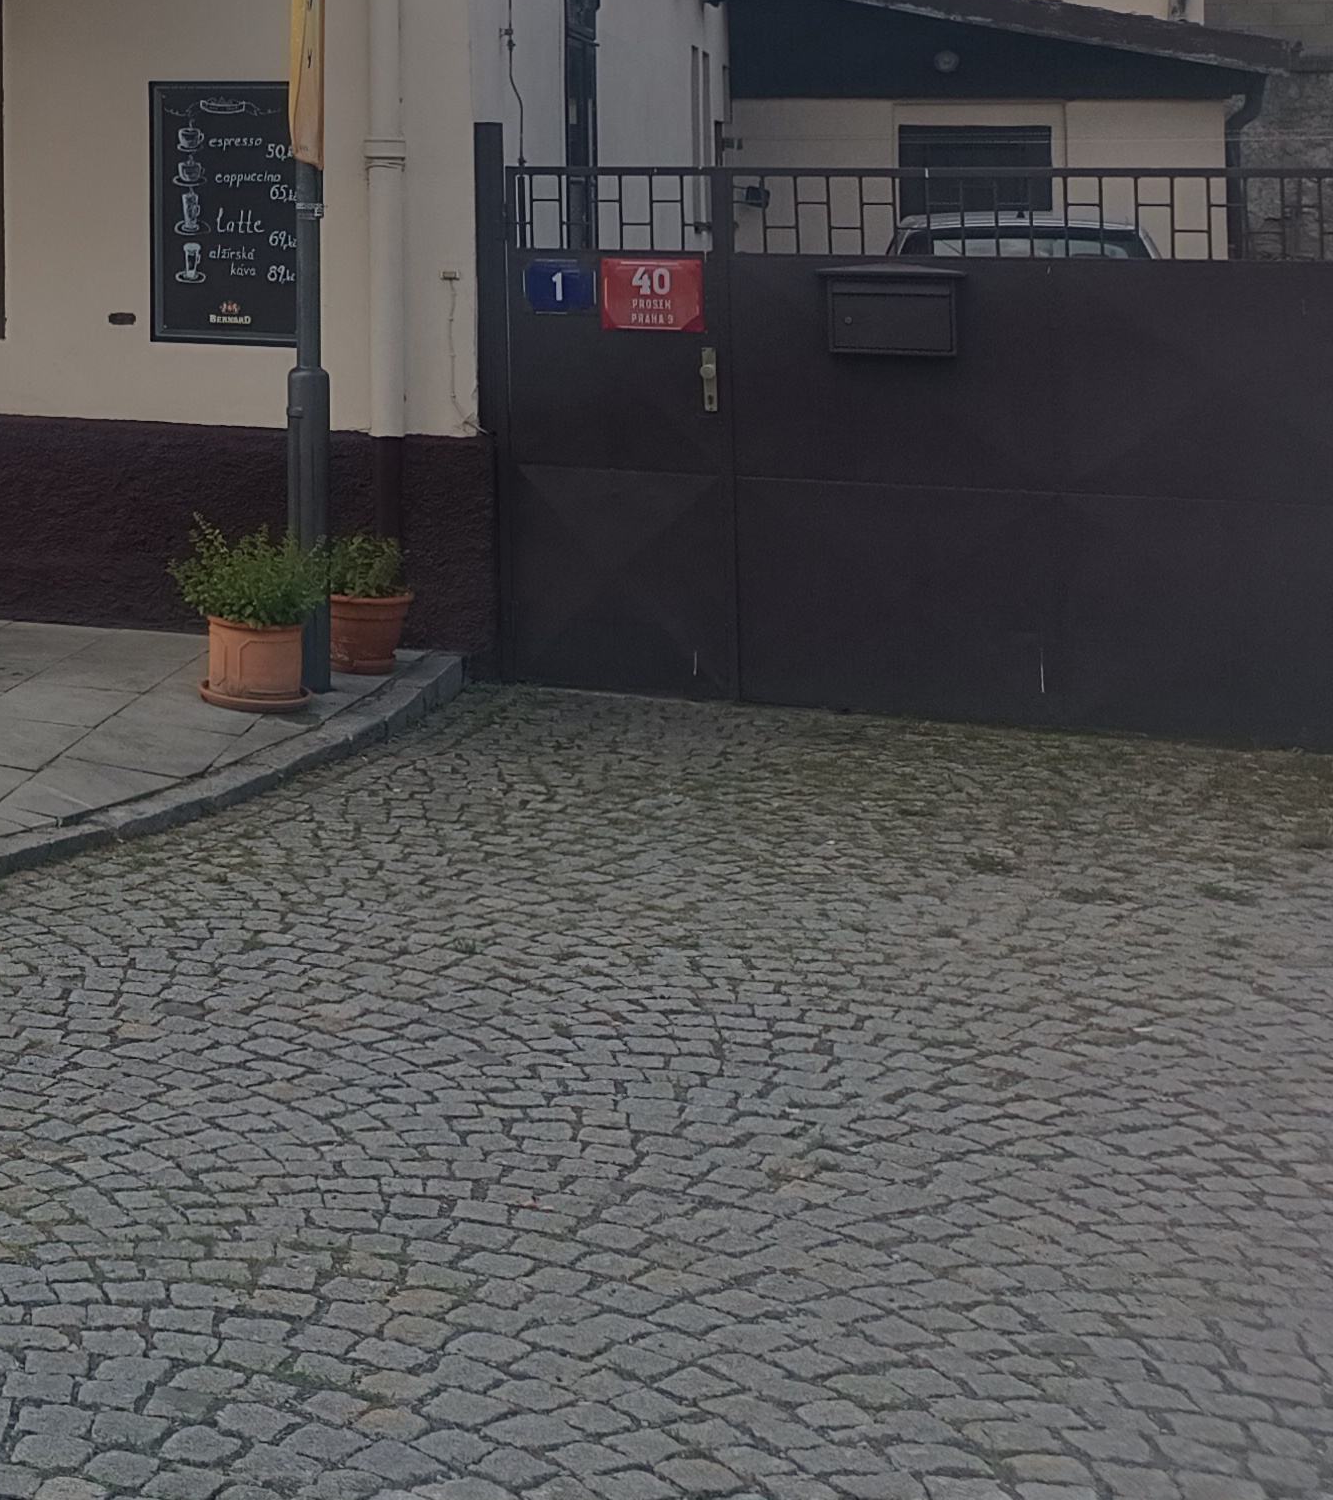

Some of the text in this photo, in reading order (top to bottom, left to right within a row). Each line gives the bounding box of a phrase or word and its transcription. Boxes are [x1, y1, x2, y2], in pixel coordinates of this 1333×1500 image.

[209, 137, 263, 151] espresso
[215, 171, 282, 188] cappuccino
[552, 272, 563, 301] 1
[632, 266, 671, 296] 40
[209, 315, 252, 325] BERNARD
[631, 313, 674, 325] PRAHA 9
